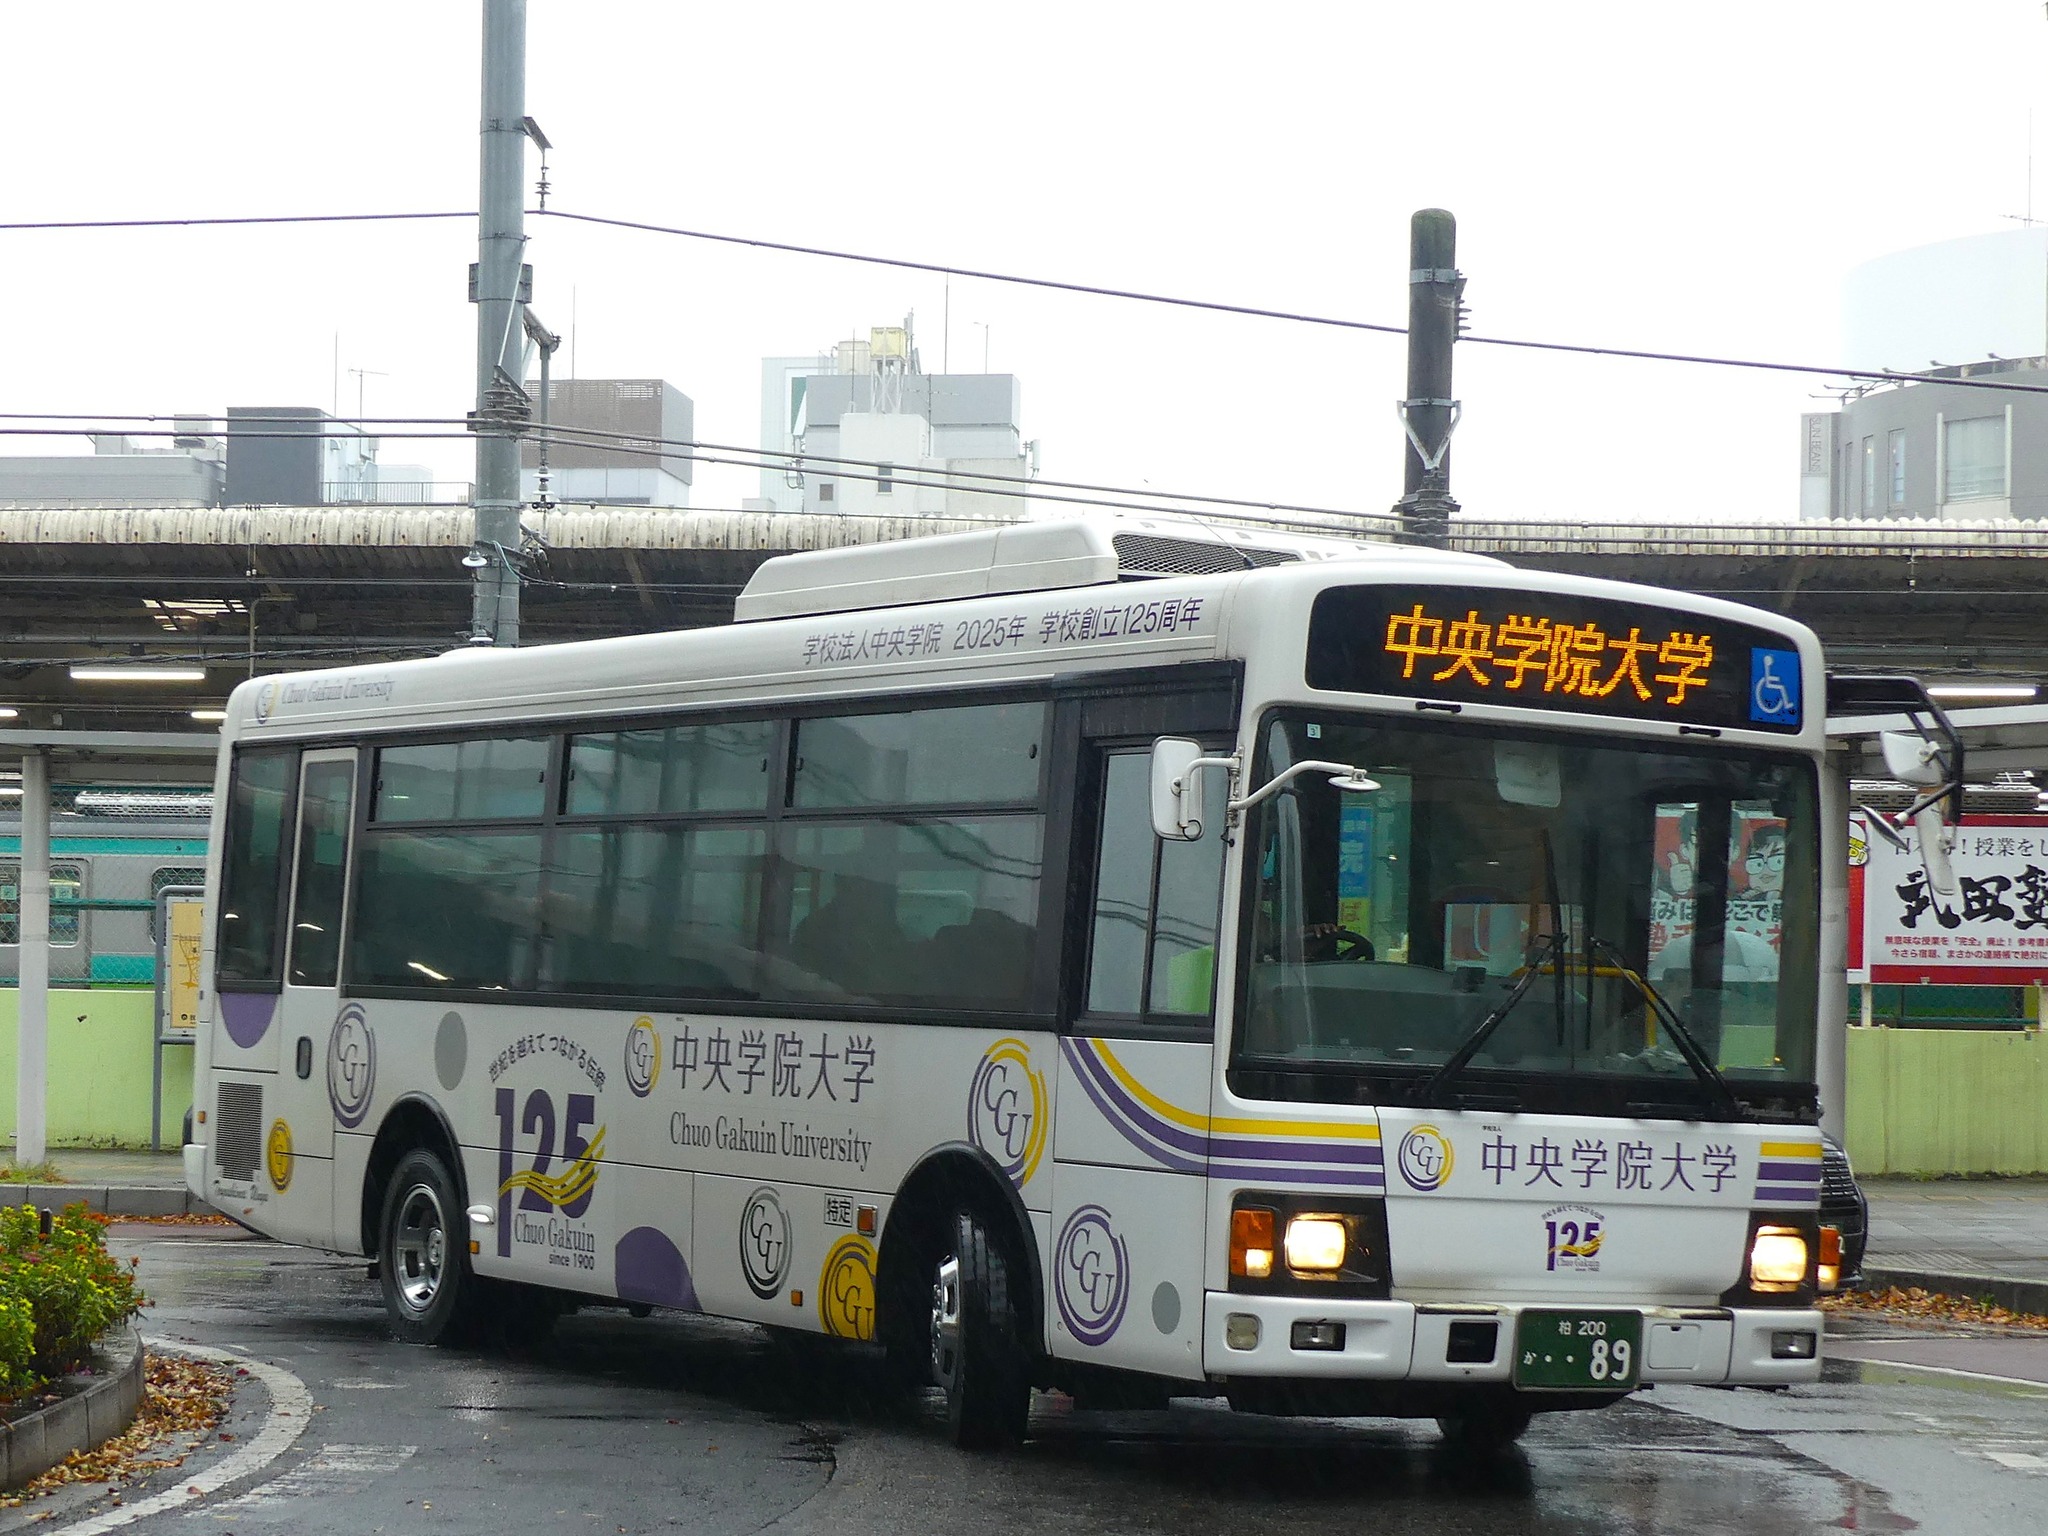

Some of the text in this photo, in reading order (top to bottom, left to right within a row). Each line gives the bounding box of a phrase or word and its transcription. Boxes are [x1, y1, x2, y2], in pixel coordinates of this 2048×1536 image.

[802, 597, 1204, 665] 学校法人中央学院 2025年 学校創立125周年
[1384, 604, 1713, 706] 中央学院大学
[1895, 837, 2048, 857] 日！授業をし
[672, 1024, 876, 1103] 中央学院大学
[984, 1065, 1032, 1159] CGU
[670, 1111, 873, 1172] Chuo Gakuin University
[1409, 1135, 1443, 1176] CGU
[1482, 1135, 1737, 1193] 中央学院大学
[495, 1087, 595, 1258] 125
[514, 1213, 595, 1253] Chuo Gakuin
[750, 1205, 782, 1274] CGU
[827, 1197, 851, 1224] 特定
[549, 1249, 595, 1270] since 1900
[1069, 1228, 1115, 1314] CGU
[1545, 1221, 1600, 1271] 125
[1558, 1320, 1607, 1336] 柏 200
[1590, 1339, 1631, 1380] 89
